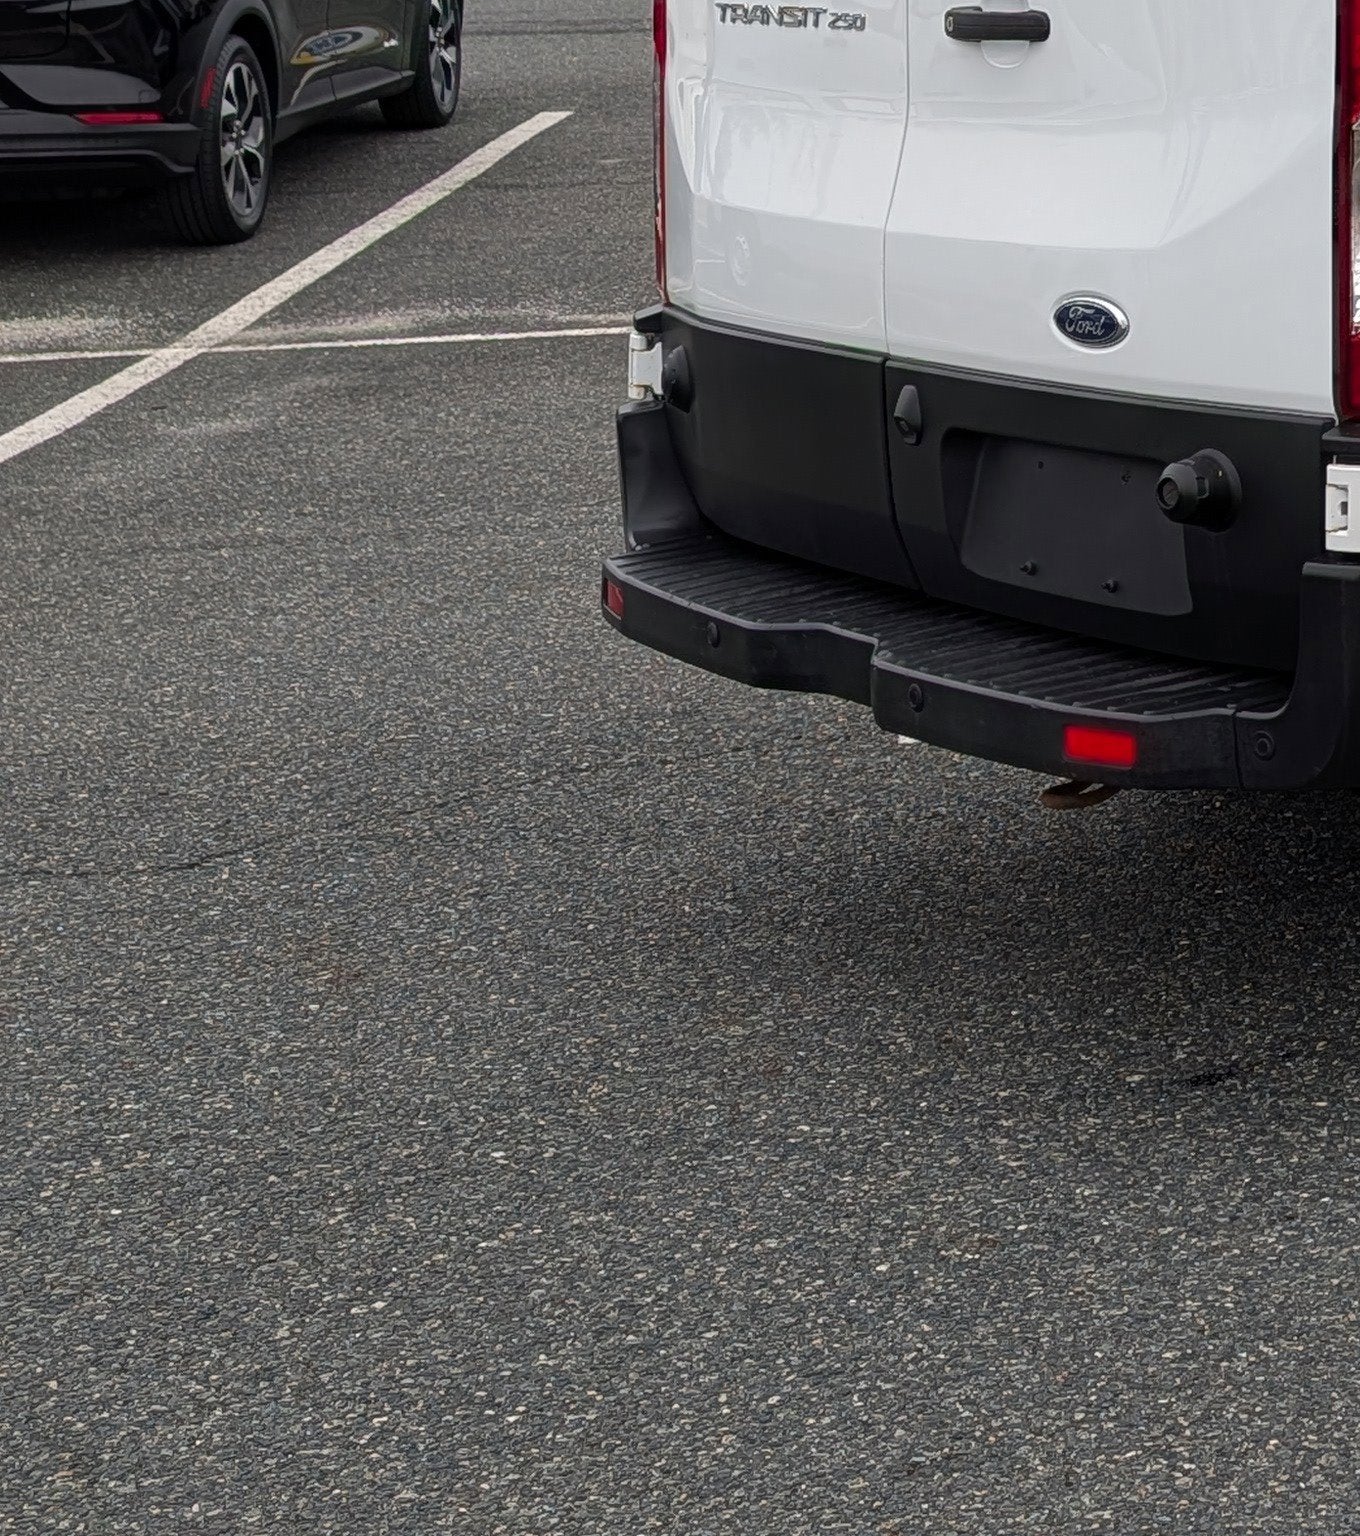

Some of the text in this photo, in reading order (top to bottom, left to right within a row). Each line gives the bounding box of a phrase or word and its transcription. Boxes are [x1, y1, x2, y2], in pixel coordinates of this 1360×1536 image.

[715, 2, 867, 32] TRANSIT 250
[1065, 305, 1106, 336] Ford
